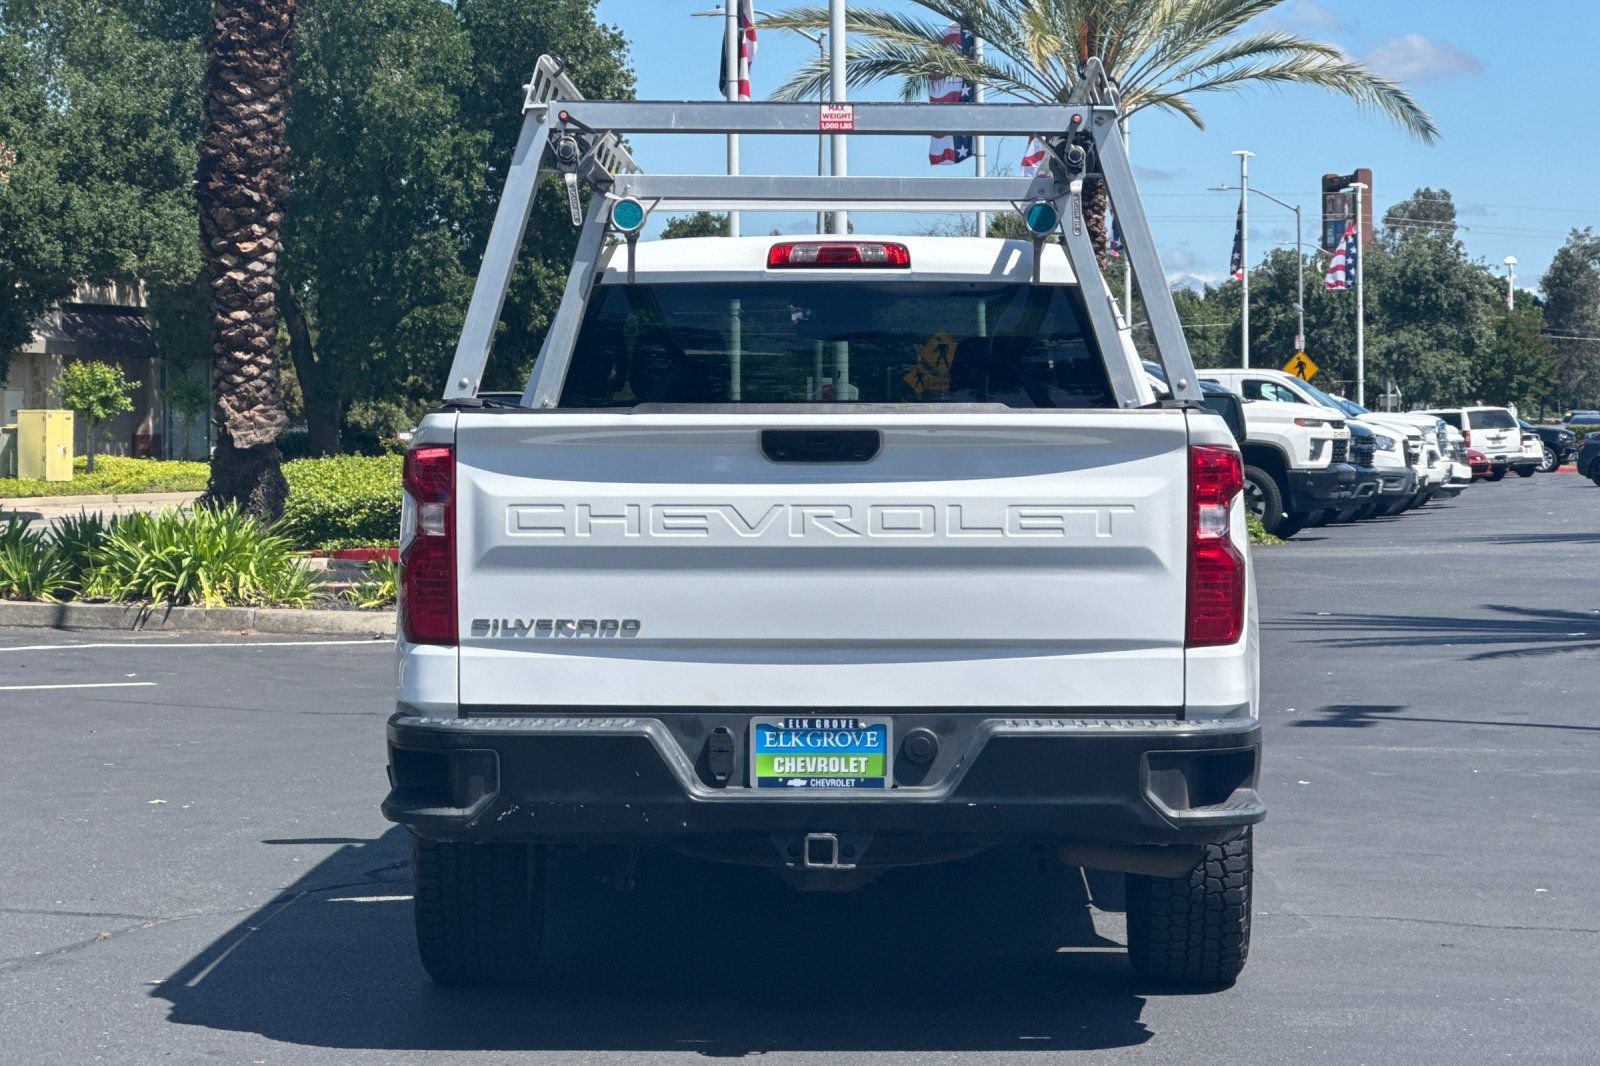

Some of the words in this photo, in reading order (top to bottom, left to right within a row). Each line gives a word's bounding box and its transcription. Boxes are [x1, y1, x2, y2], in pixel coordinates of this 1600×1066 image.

[505, 504, 1136, 538] CHEVROLET
[470, 618, 641, 632] SILVERADO
[788, 719, 809, 729] ELK
[815, 719, 854, 729] GROVE
[773, 756, 868, 773] CHEVROLET
[810, 778, 855, 787] CHEVROLET
